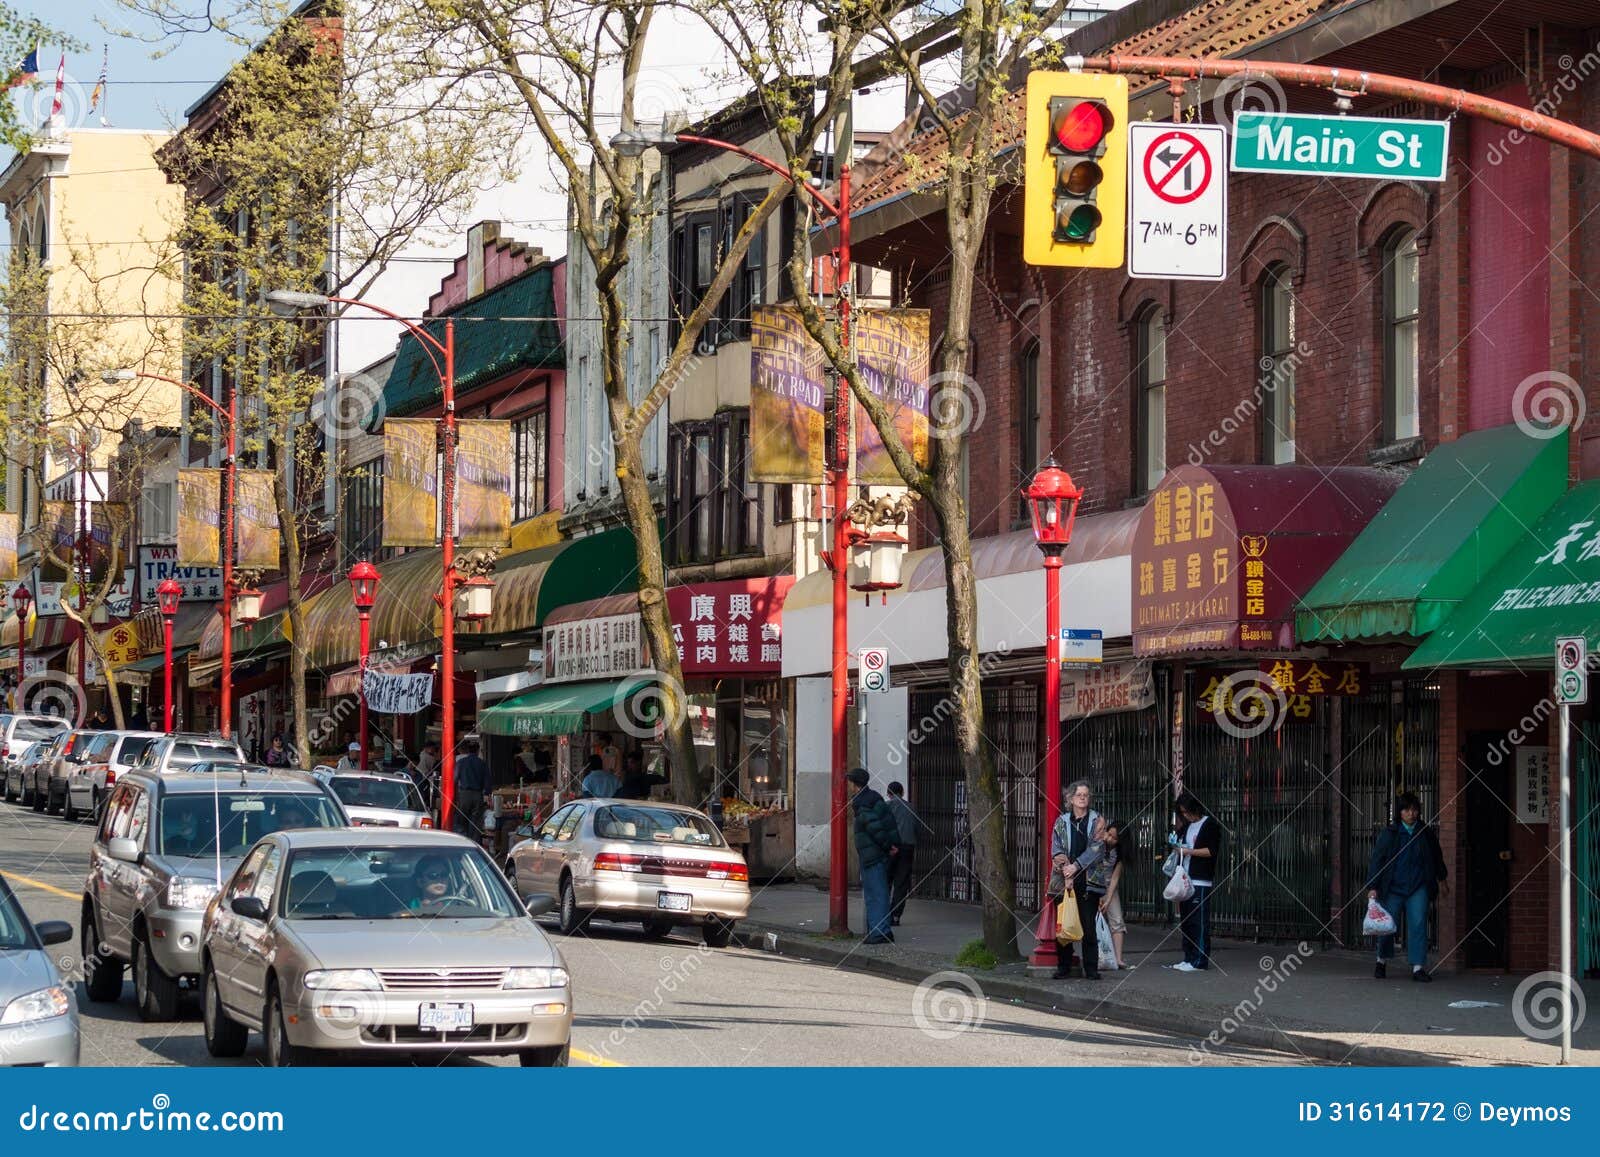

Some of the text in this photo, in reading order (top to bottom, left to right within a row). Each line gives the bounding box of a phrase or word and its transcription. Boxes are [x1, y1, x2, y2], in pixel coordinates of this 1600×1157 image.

[1256, 125, 1422, 168] Main St
[759, 364, 820, 408] SILK ROAD
[894, 379, 925, 410] ROAD
[151, 548, 177, 559] WAN
[144, 562, 219, 579] TRAVEL
[689, 594, 753, 622] 廣興
[1139, 602, 1180, 625] ULTIMATE
[1200, 597, 1229, 618] KARAT
[1077, 688, 1096, 713] FOR
[1099, 682, 1129, 710] LEASE
